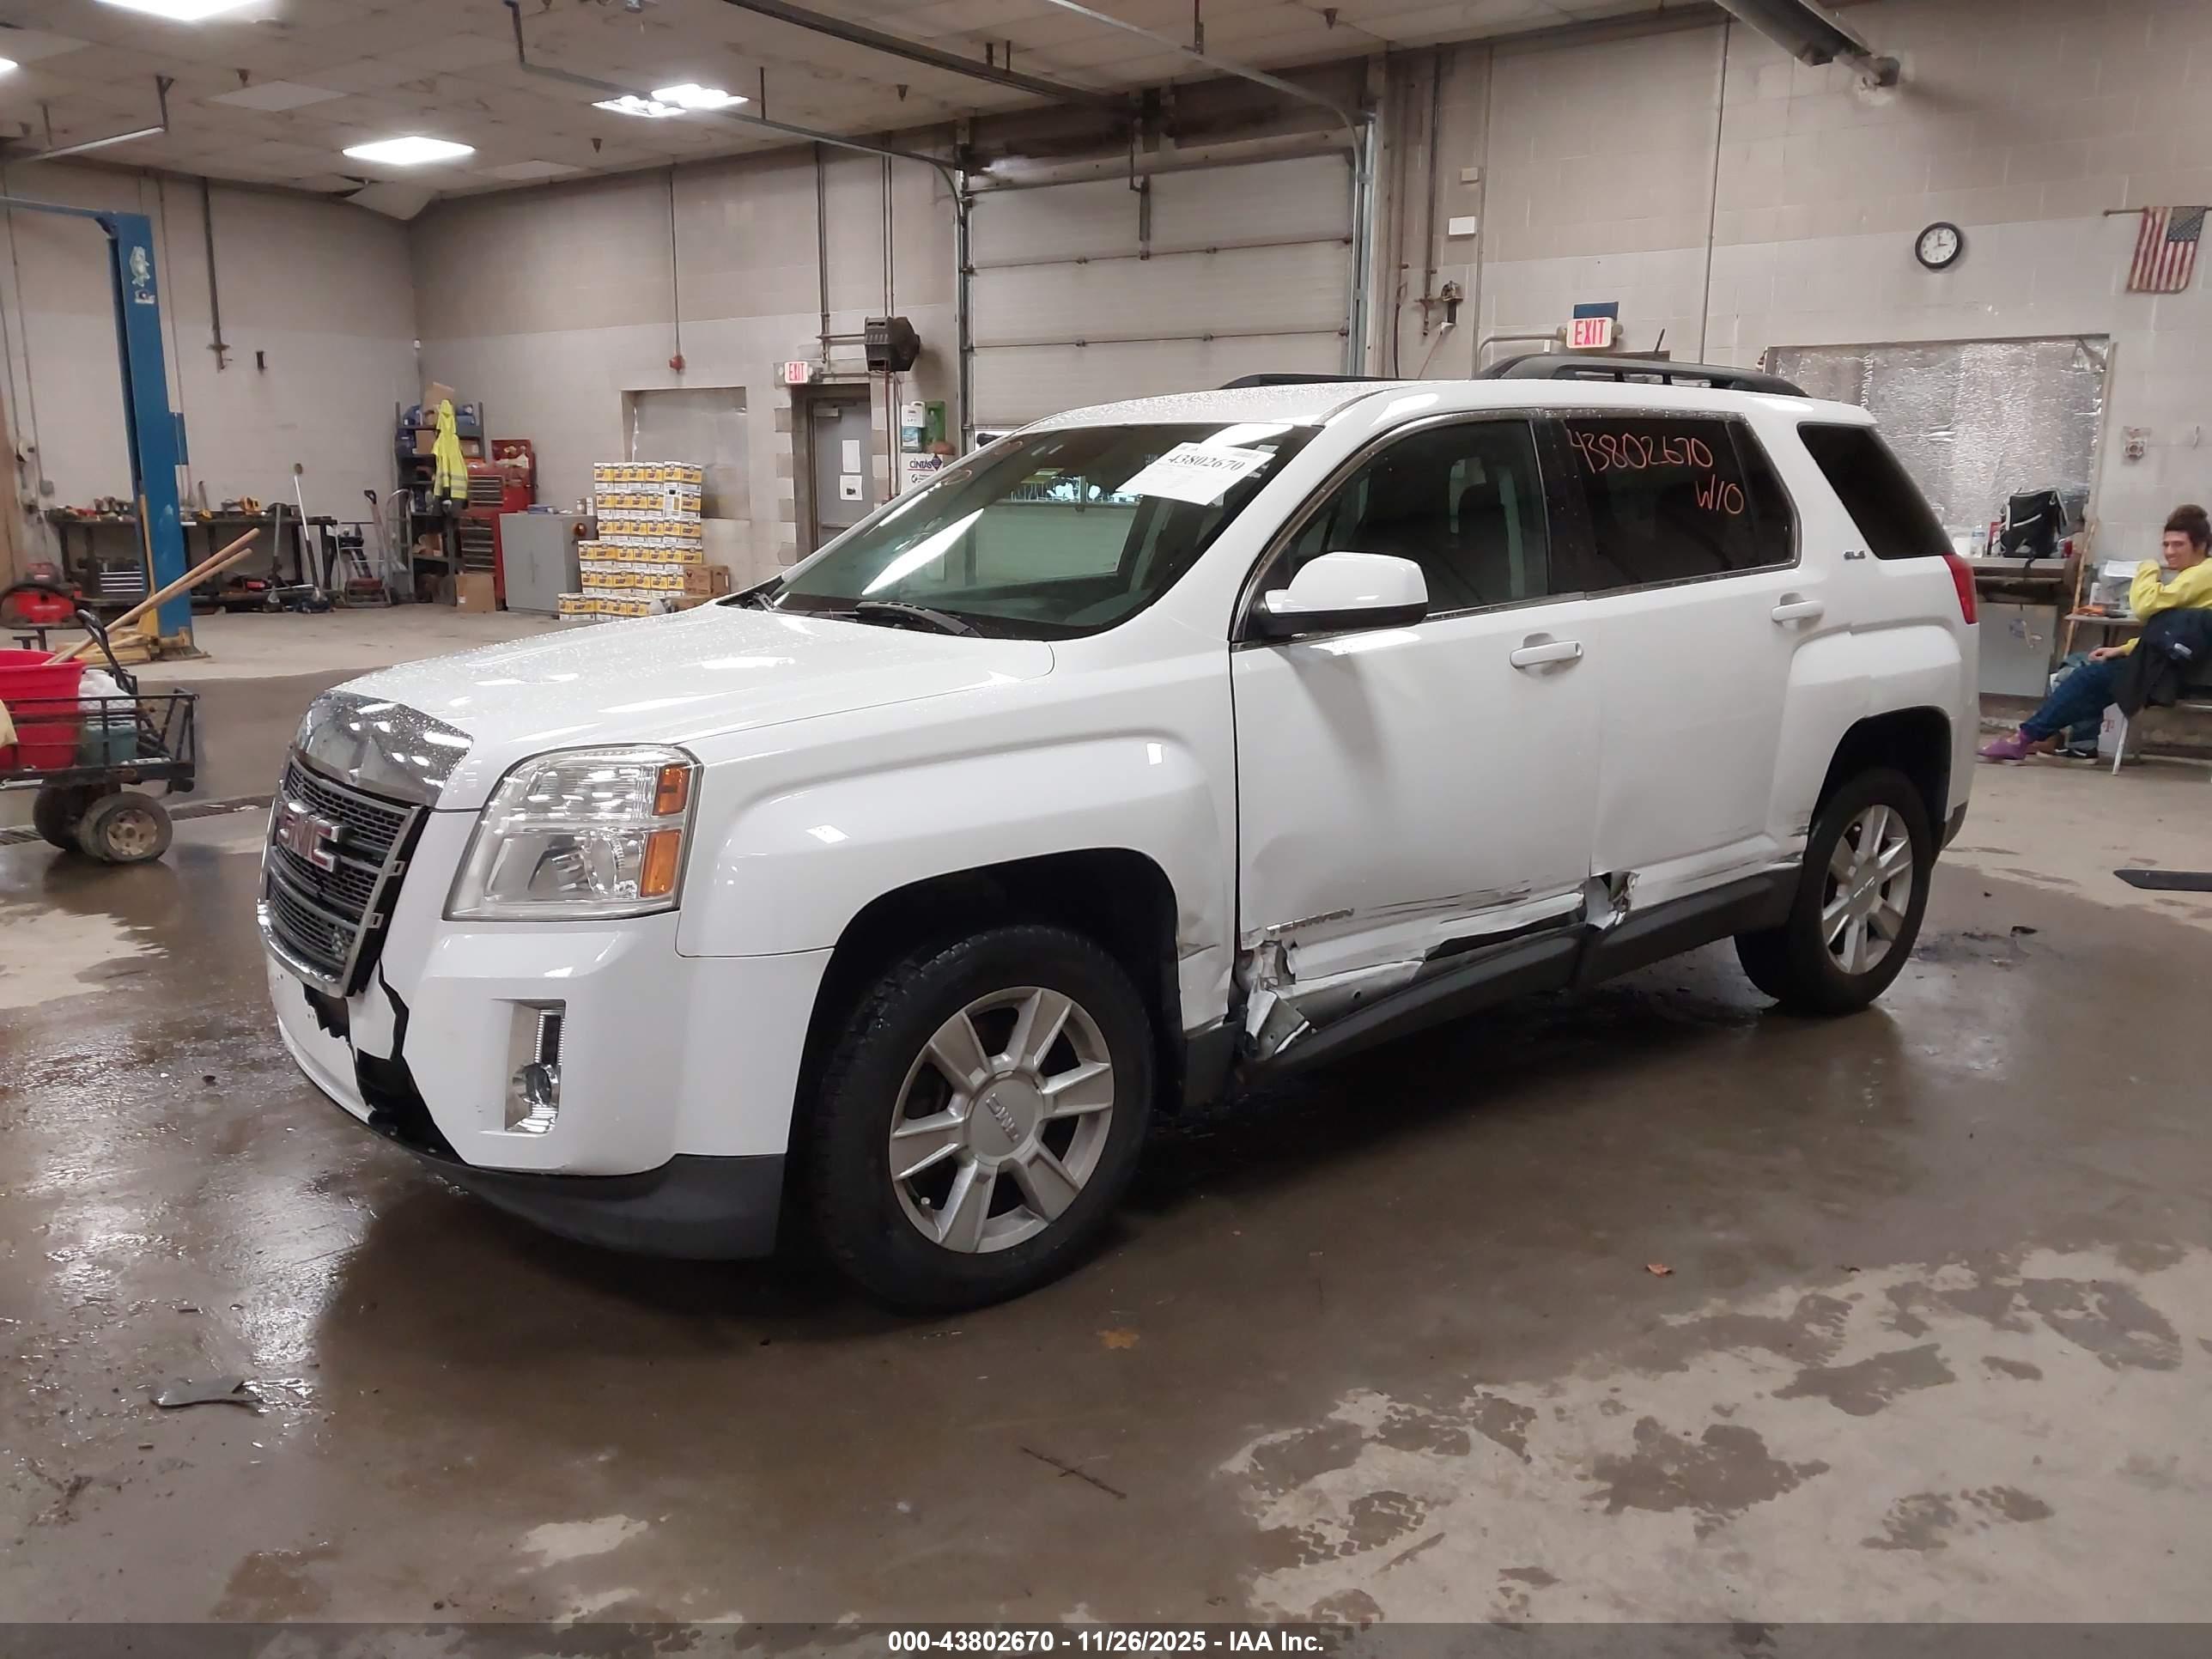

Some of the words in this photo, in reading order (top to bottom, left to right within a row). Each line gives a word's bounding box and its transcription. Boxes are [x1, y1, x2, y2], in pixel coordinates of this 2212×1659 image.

[1574, 319, 1607, 345] EXIT
[788, 362, 805, 381] EXIT
[1168, 453, 1245, 471] 43802670
[1568, 429, 1713, 473] 43802670
